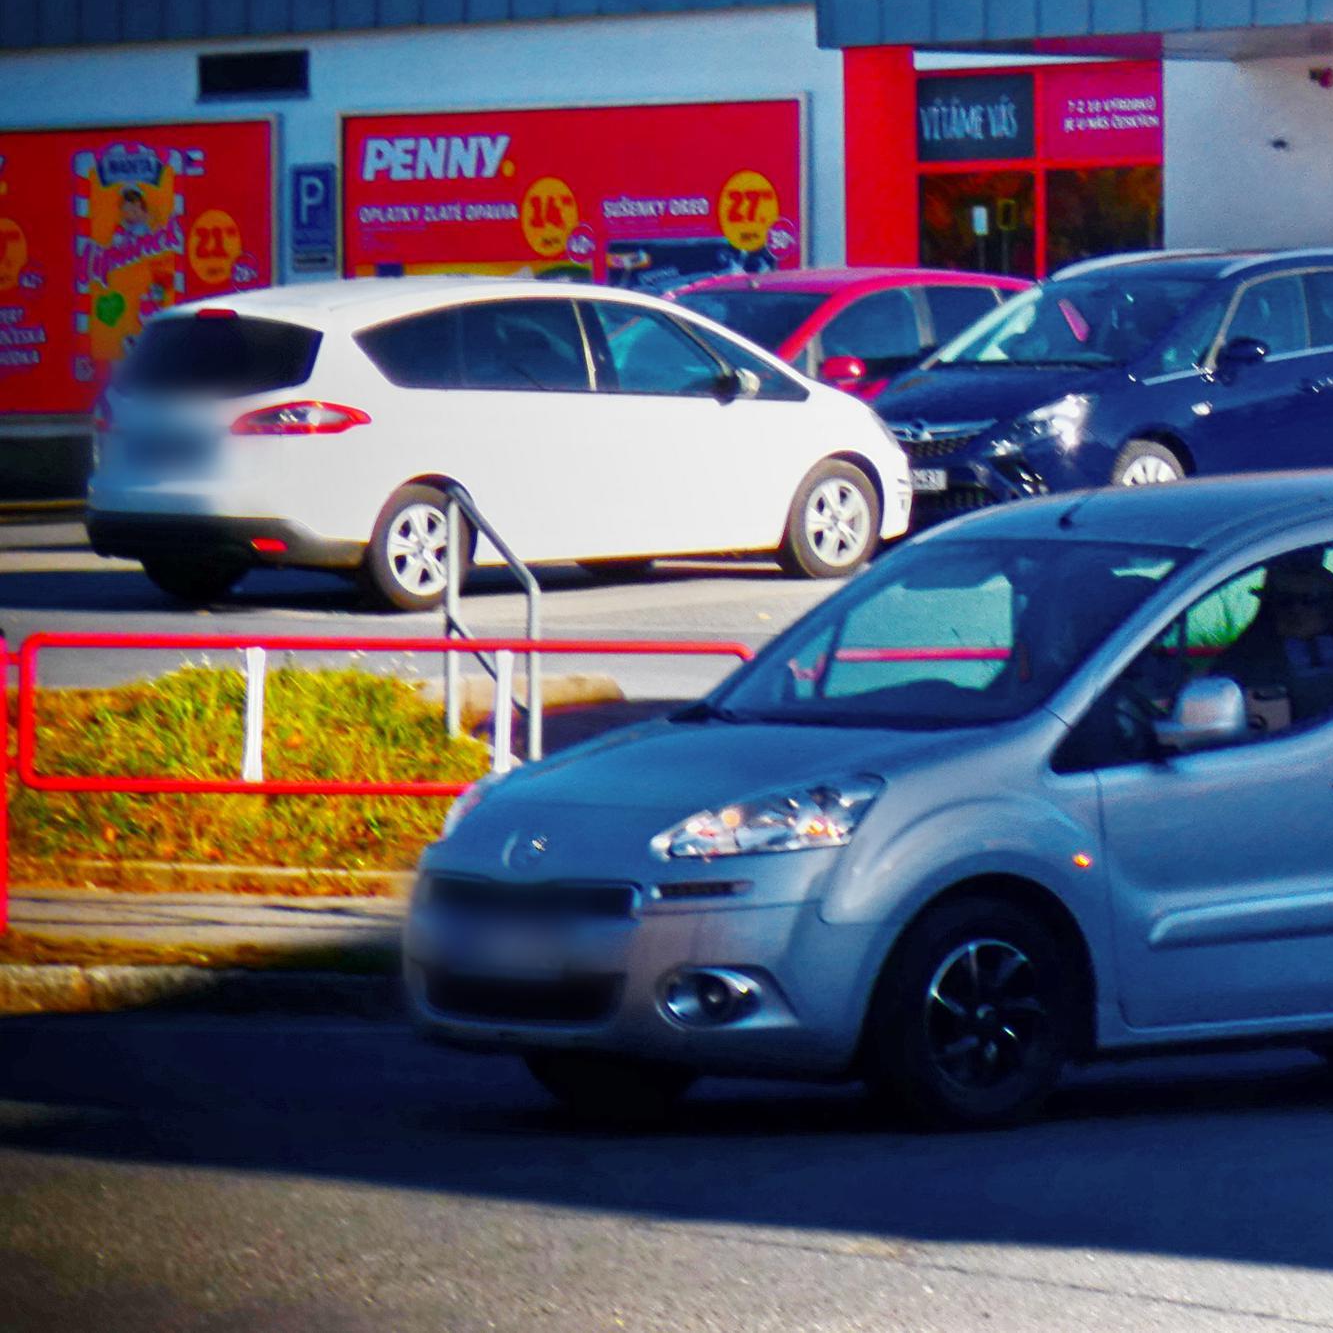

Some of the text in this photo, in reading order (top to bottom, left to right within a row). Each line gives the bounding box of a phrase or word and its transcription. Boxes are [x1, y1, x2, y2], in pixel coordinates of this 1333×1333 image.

[920, 94, 1018, 140] VÍTÁME VÁS
[301, 176, 325, 224] P
[359, 204, 419, 223] OPLATKY
[423, 200, 463, 222] ZLATÉ
[603, 196, 710, 218] SUŠENKY OREO
